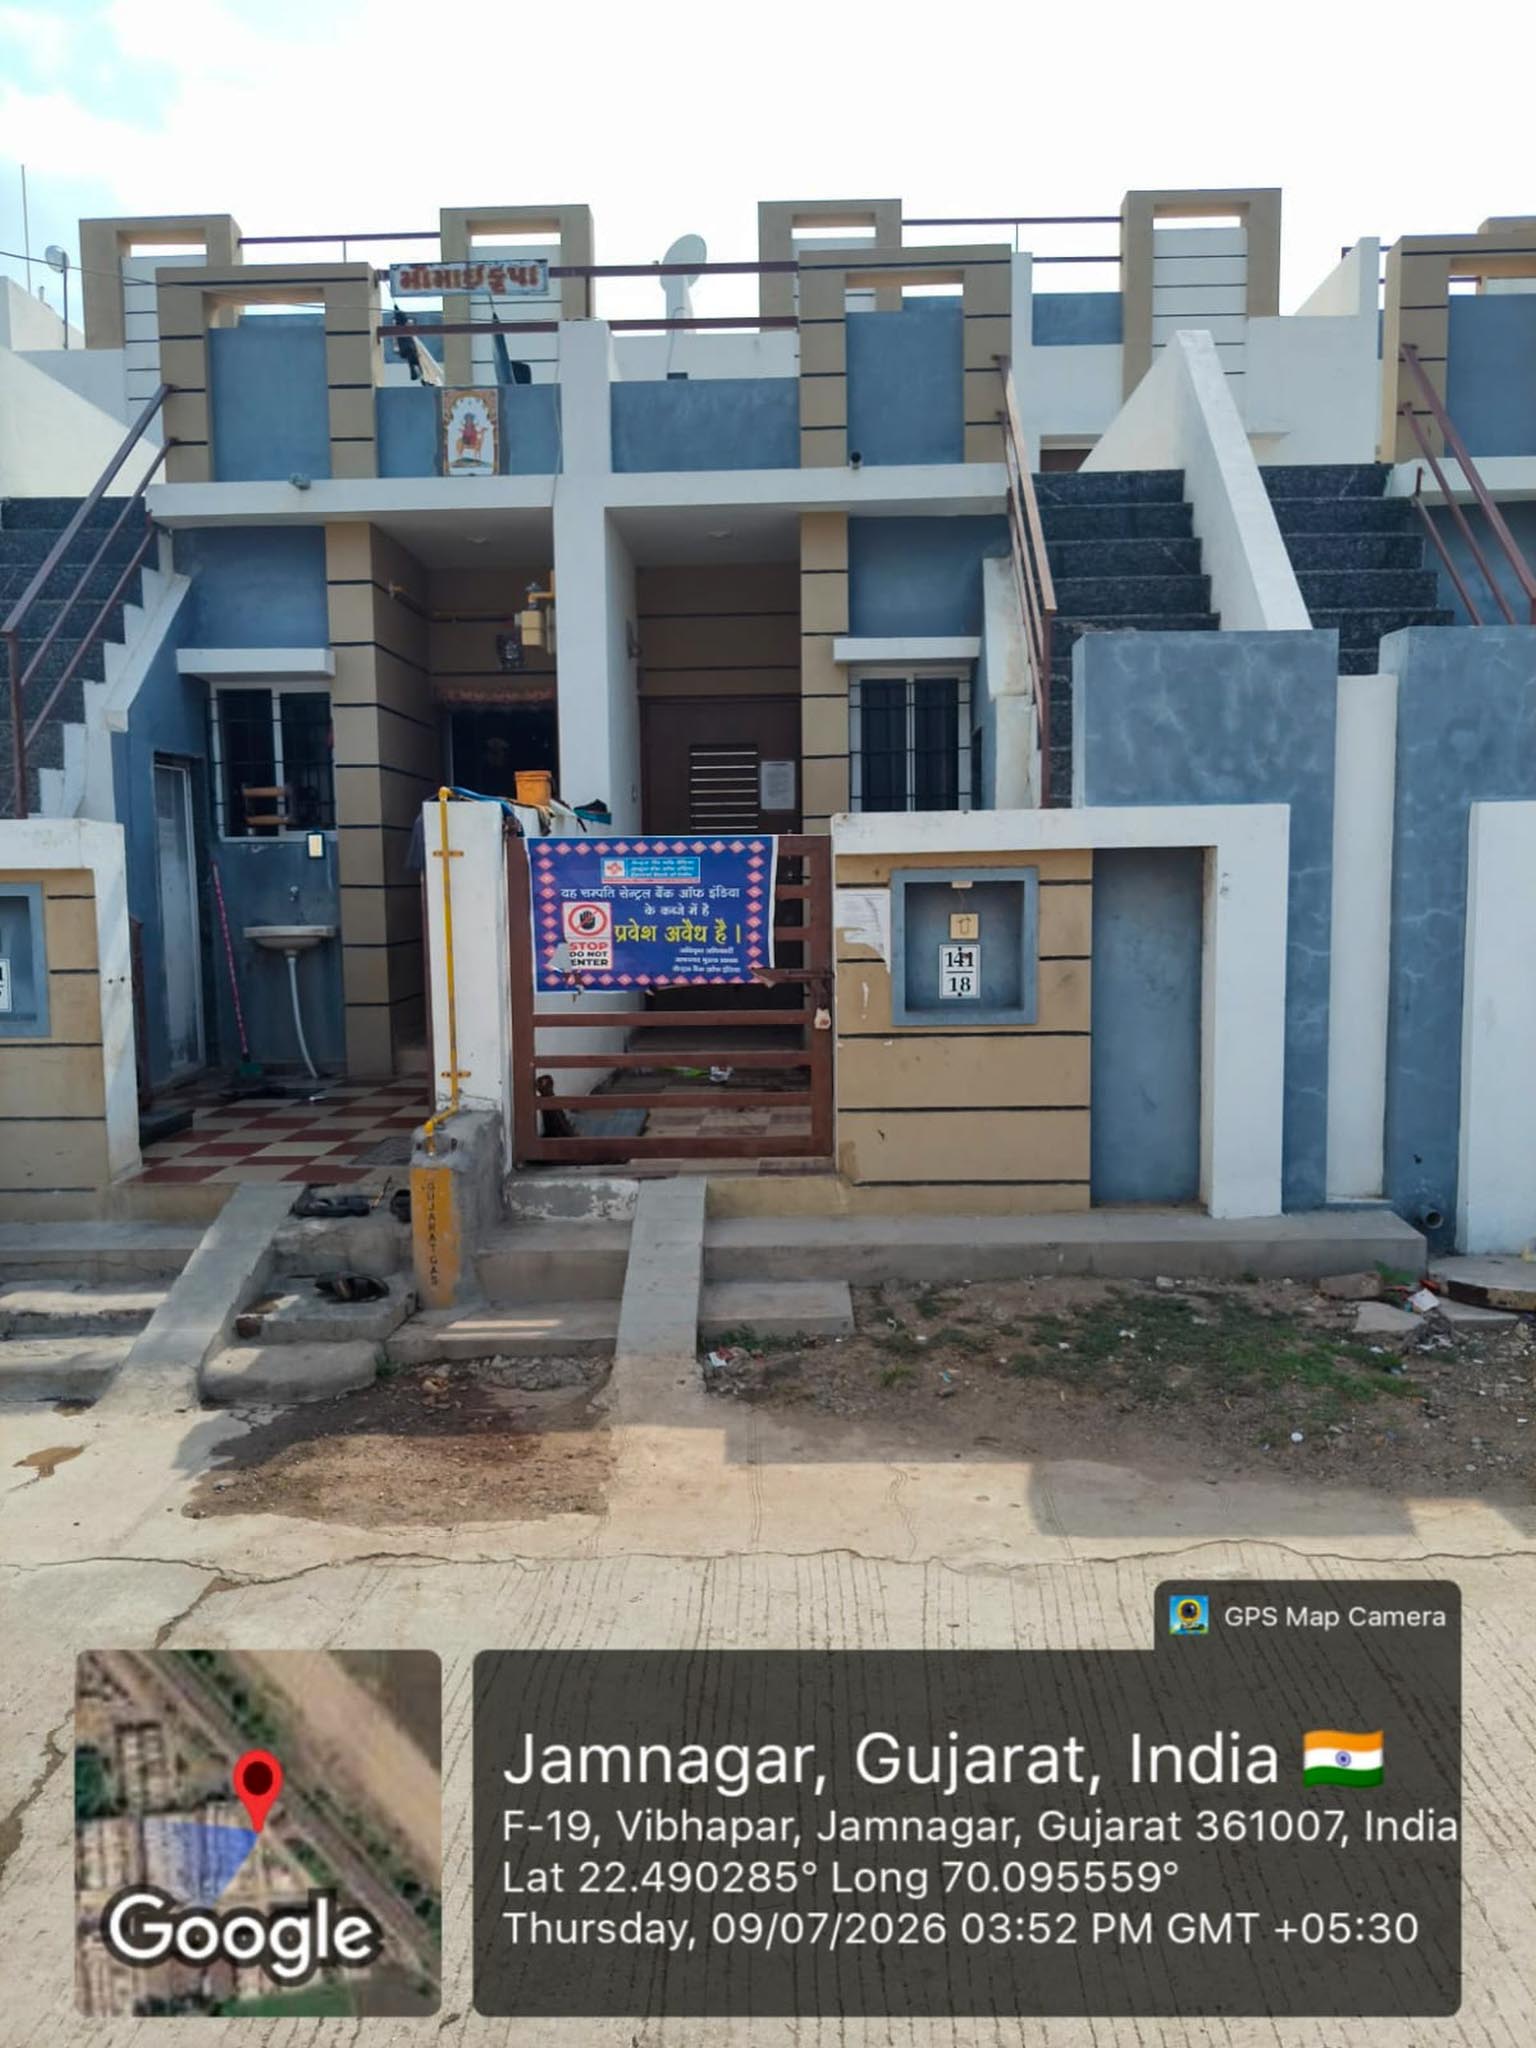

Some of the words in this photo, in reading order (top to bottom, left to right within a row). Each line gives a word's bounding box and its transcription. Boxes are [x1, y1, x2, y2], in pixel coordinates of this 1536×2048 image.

[561, 887, 577, 899] यह
[679, 885, 705, 899] ऑफ
[709, 884, 740, 899] इंडिया
[644, 902, 656, 916] के
[688, 902, 698, 916] में
[701, 902, 710, 917] है
[614, 917, 658, 943] प्रवेश
[664, 917, 708, 942] अवैध
[714, 917, 728, 944] है
[570, 941, 608, 950] STOP
[569, 950, 585, 958] DO
[587, 950, 608, 958] NOT
[944, 951, 974, 968] 141
[571, 958, 609, 967] ENTER
[950, 976, 972, 993] 18
